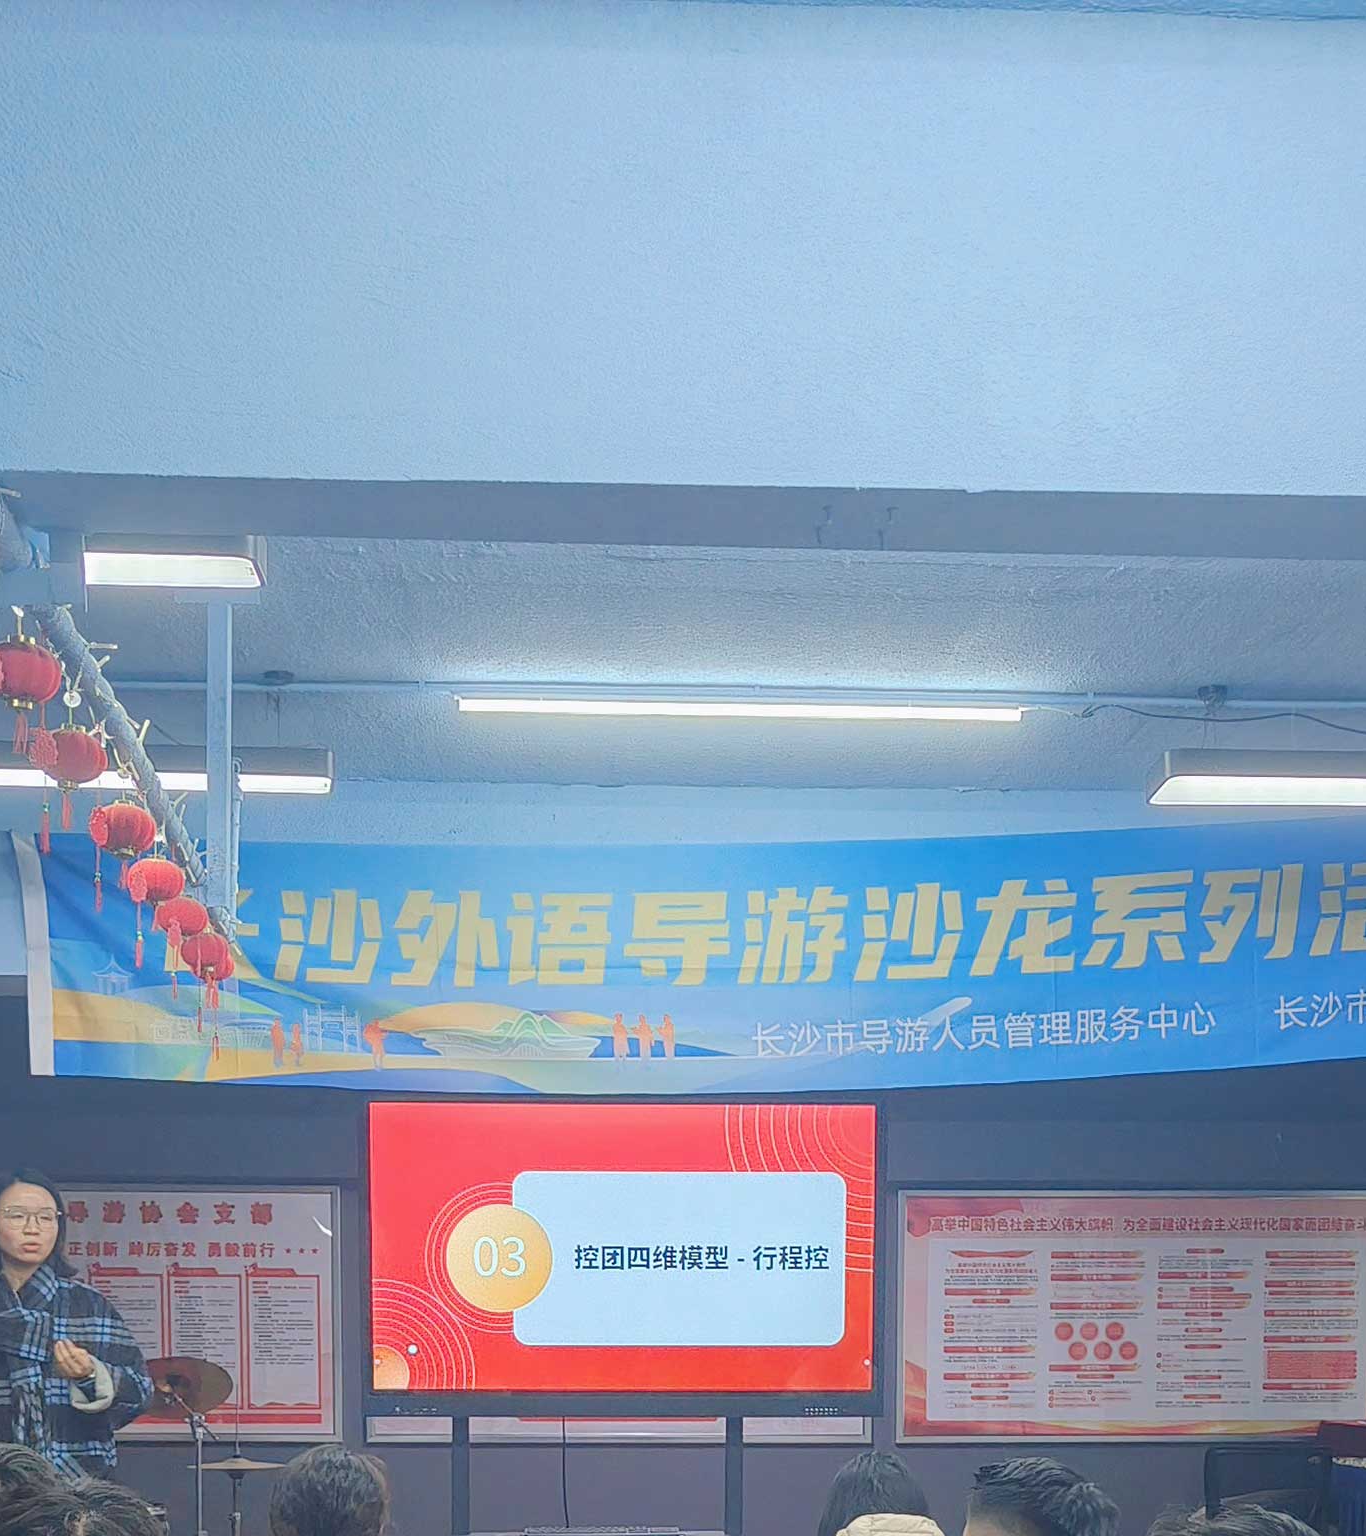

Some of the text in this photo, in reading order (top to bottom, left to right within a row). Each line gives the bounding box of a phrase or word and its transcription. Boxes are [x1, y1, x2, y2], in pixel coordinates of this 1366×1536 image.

[751, 1000, 1216, 1056] 长沙市导游人员管理服务中心
[473, 1237, 526, 1277] 03
[575, 1245, 730, 1271] 控团四维模型
[753, 1245, 830, 1271] 行程控
